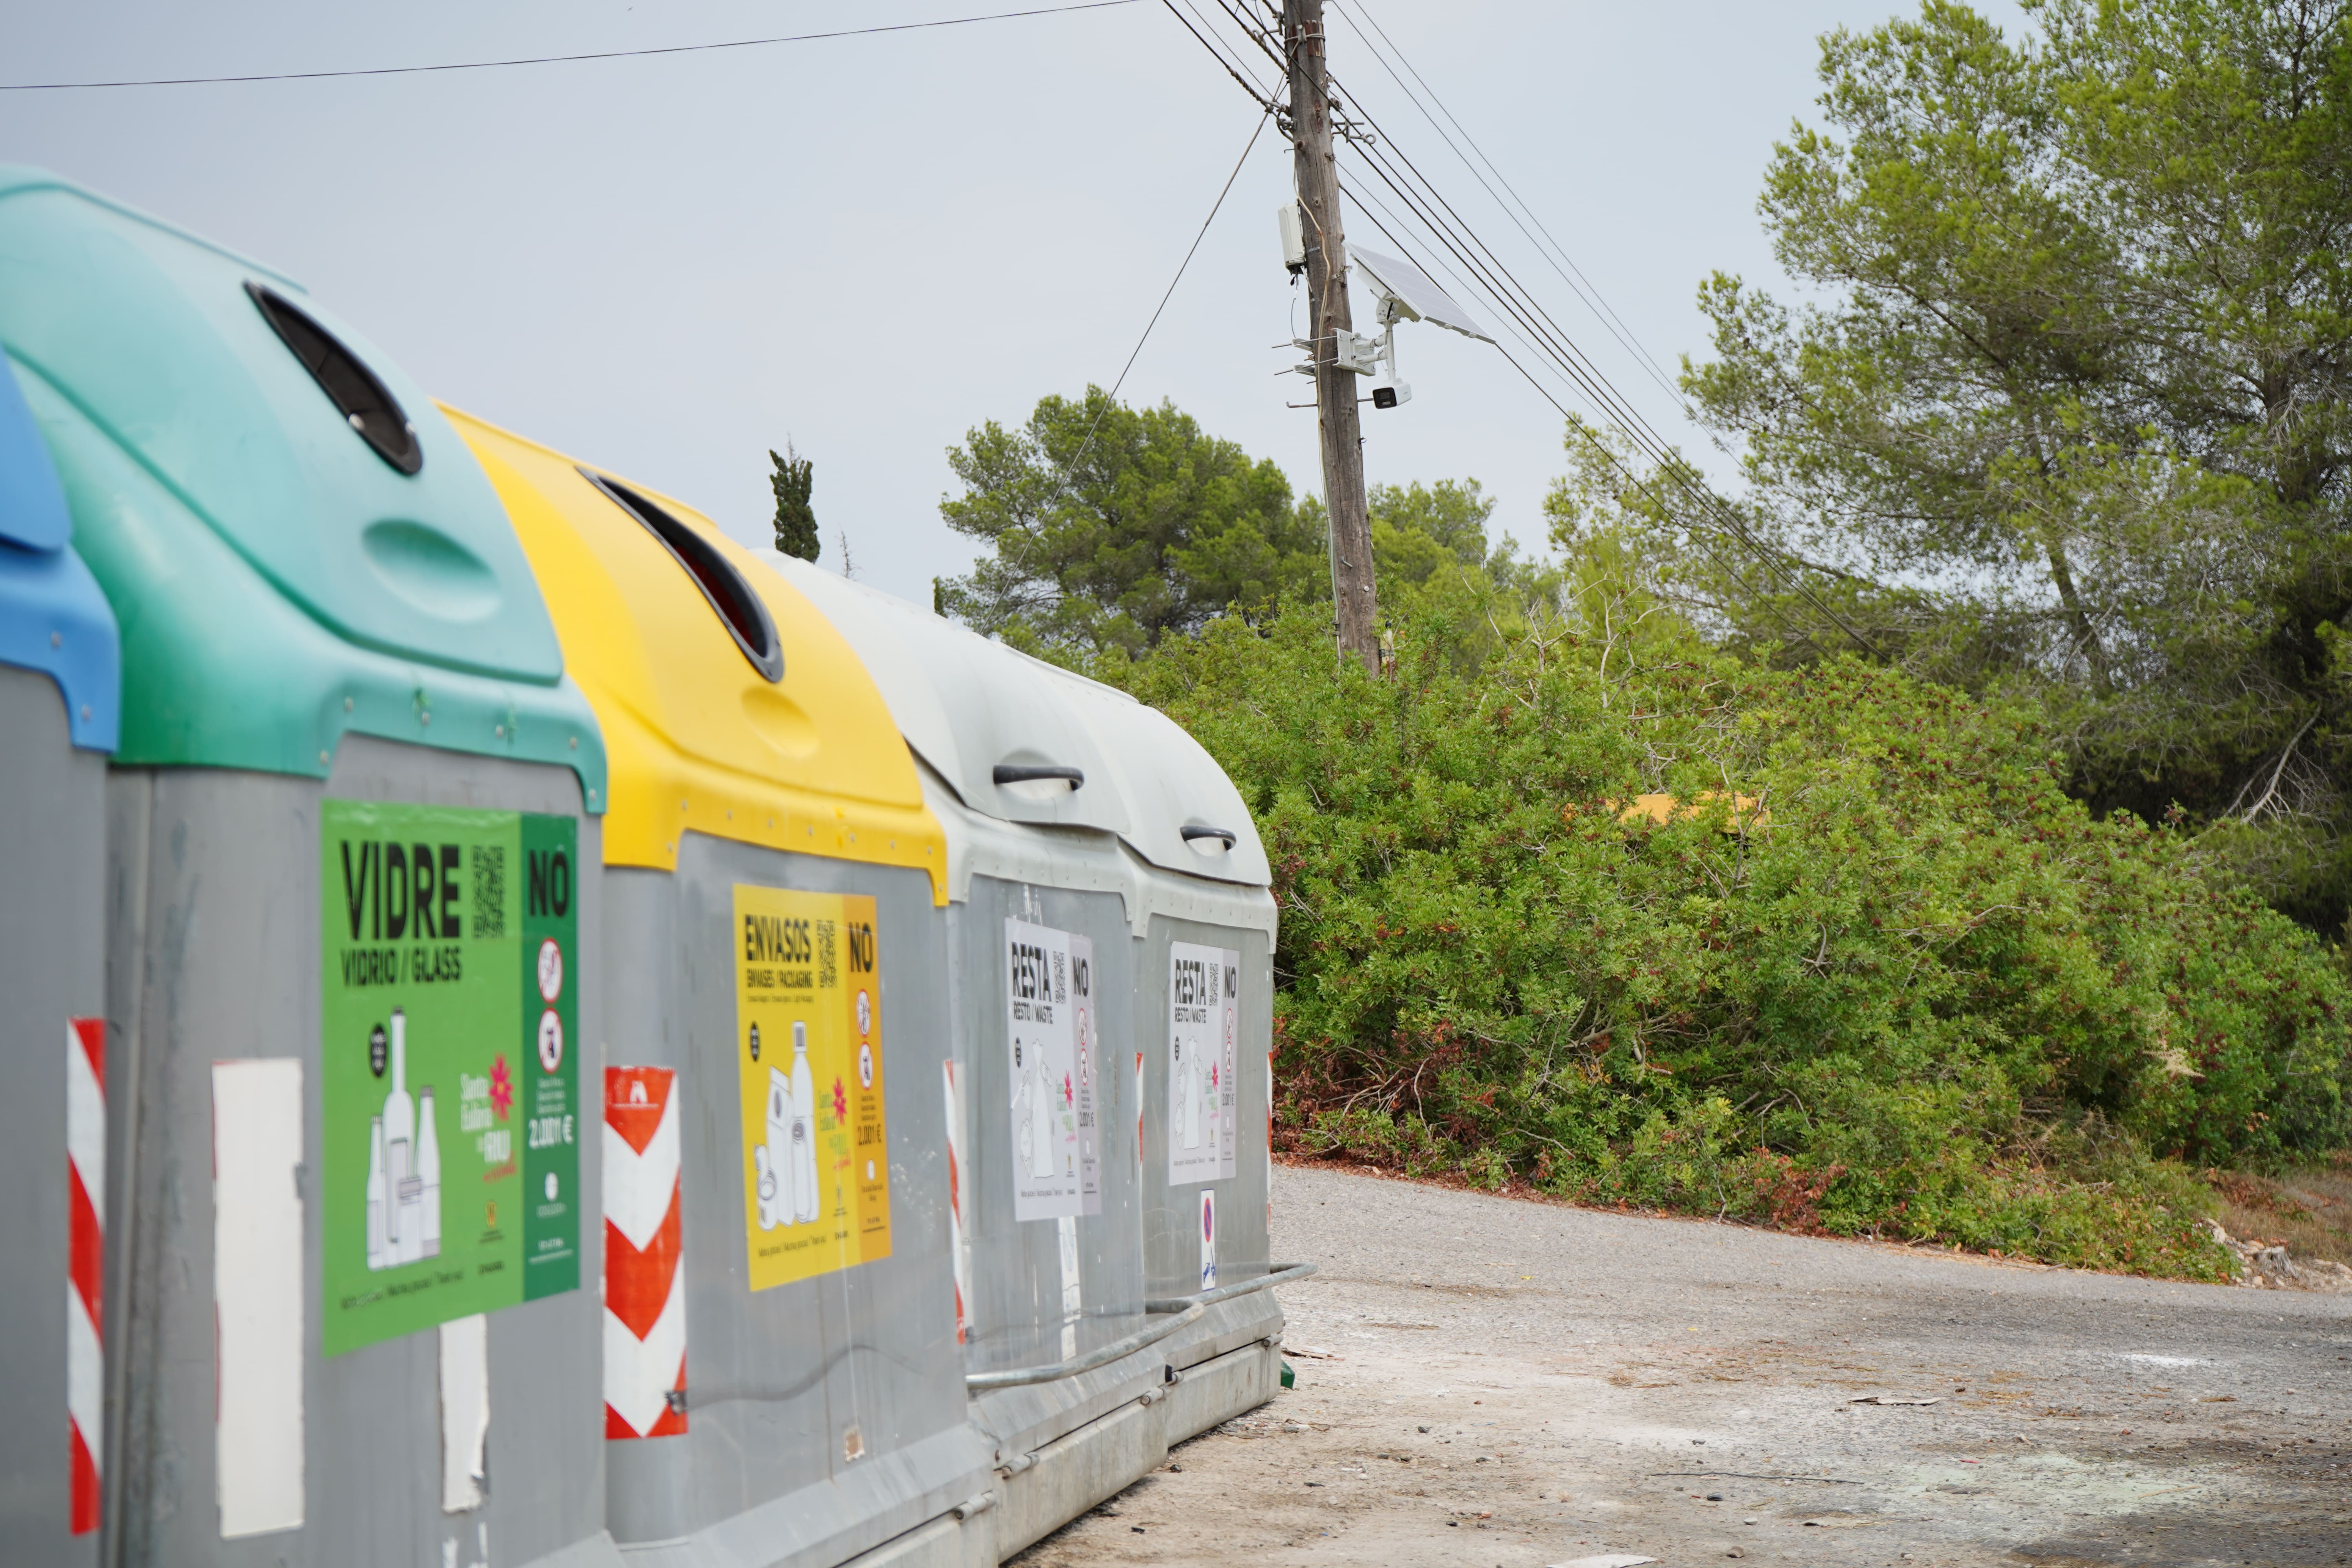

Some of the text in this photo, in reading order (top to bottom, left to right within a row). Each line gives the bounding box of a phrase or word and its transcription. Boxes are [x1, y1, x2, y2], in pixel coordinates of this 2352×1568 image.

[340, 840, 460, 940] VIDRE
[529, 849, 568, 917] NO
[745, 914, 811, 963] ENVASOS
[849, 922, 873, 973] NO
[340, 947, 396, 986] VIDRIO
[413, 946, 461, 982] GLASS
[747, 968, 775, 988] ENVASES
[779, 970, 813, 989] PACKAGING
[1012, 942, 1052, 1002] RESTA
[1073, 956, 1089, 997] NO
[1175, 959, 1206, 1005] RESTA
[1225, 966, 1236, 998] NO
[1014, 1001, 1031, 1020] RESTO
[1034, 1004, 1053, 1024] WASTE
[1175, 1007, 1188, 1022] RESTO
[1192, 1008, 1206, 1023] WASTE
[461, 1073, 490, 1100] Santa
[819, 1090, 833, 1109] Santa
[1223, 1094, 1231, 1105] 2.001
[1232, 1094, 1234, 1105] €
[529, 1114, 574, 1149] 2.001 €
[858, 1124, 881, 1145] 2.001 €
[1080, 1112, 1090, 1127] 2.001
[1091, 1112, 1094, 1127] €
